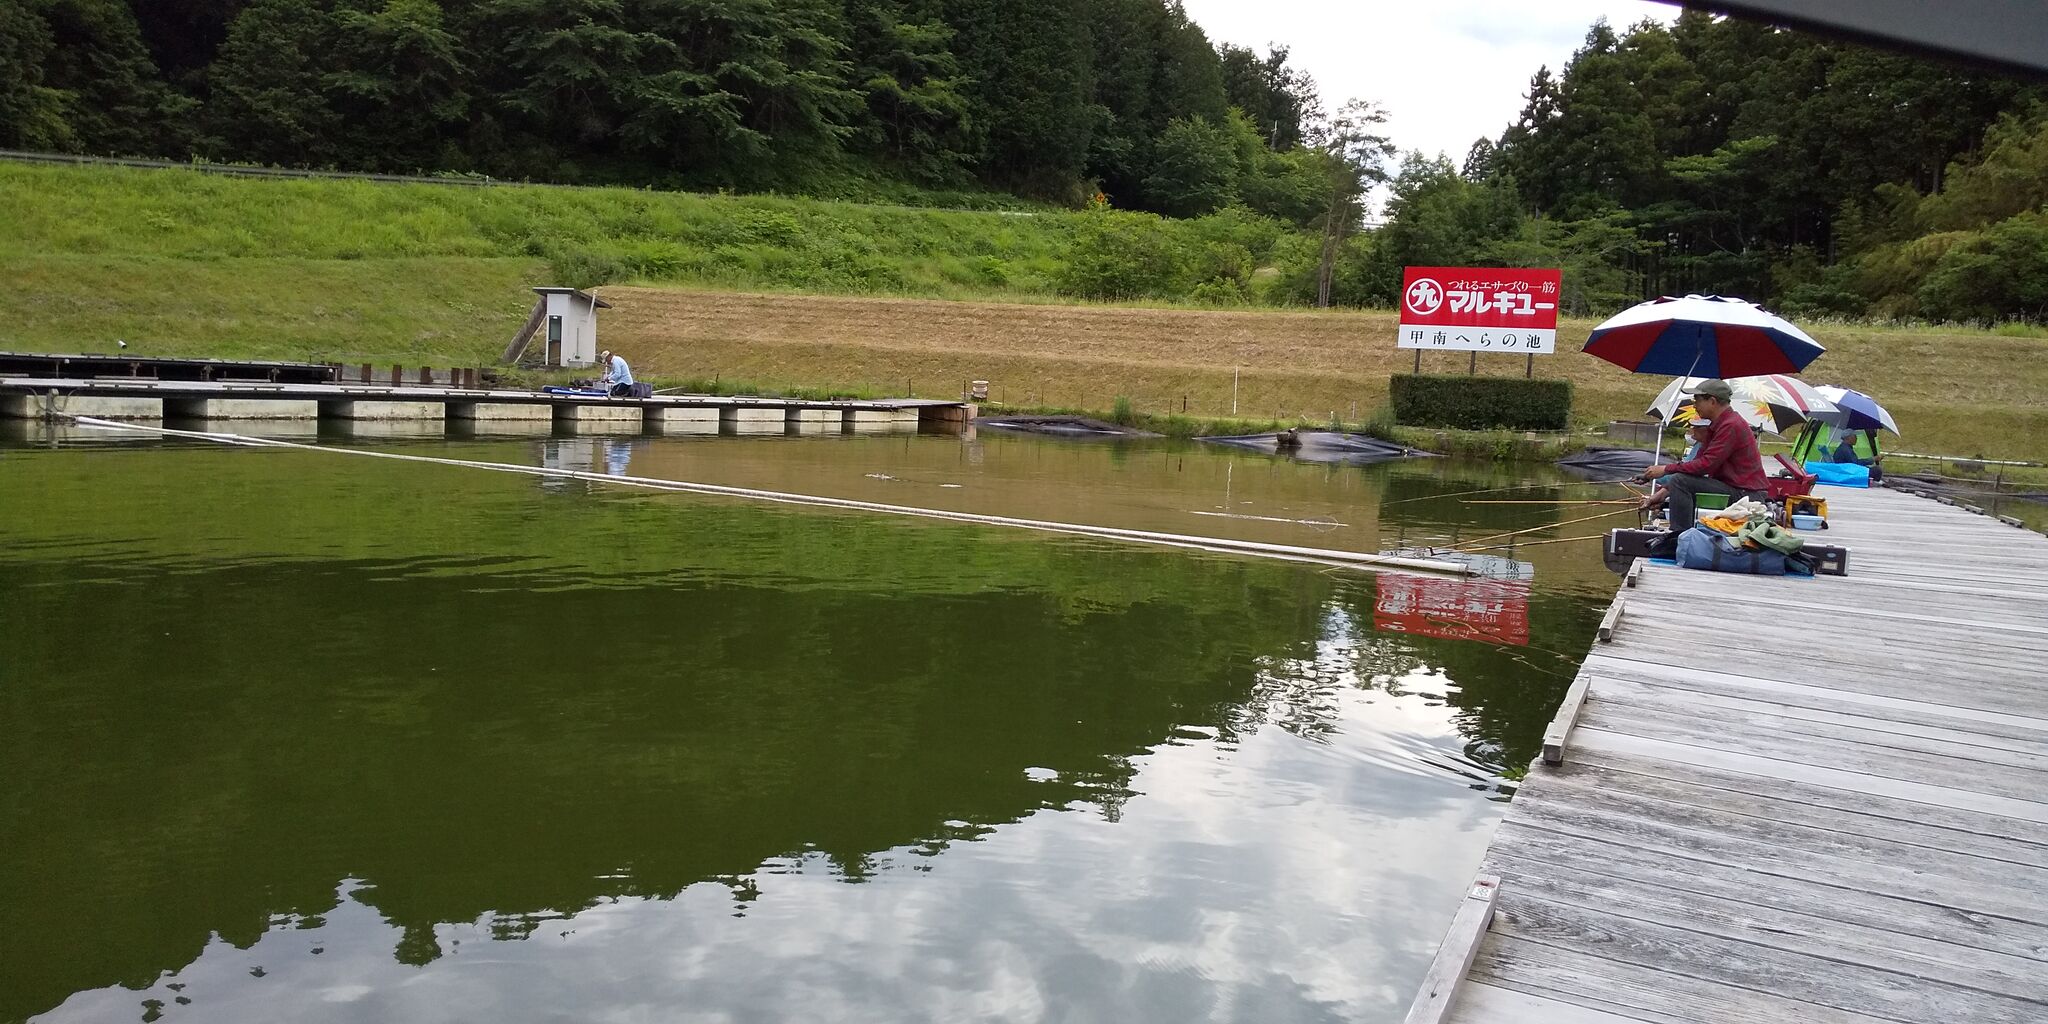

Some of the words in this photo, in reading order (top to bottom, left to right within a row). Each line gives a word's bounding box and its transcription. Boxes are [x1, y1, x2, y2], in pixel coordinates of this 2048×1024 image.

[1409, 280, 1440, 310] 九
[1447, 279, 1555, 294] つれるエサづくり一筋
[1445, 290, 1555, 315] マルキュー
[1410, 330, 1541, 349] 甲南へらの池
